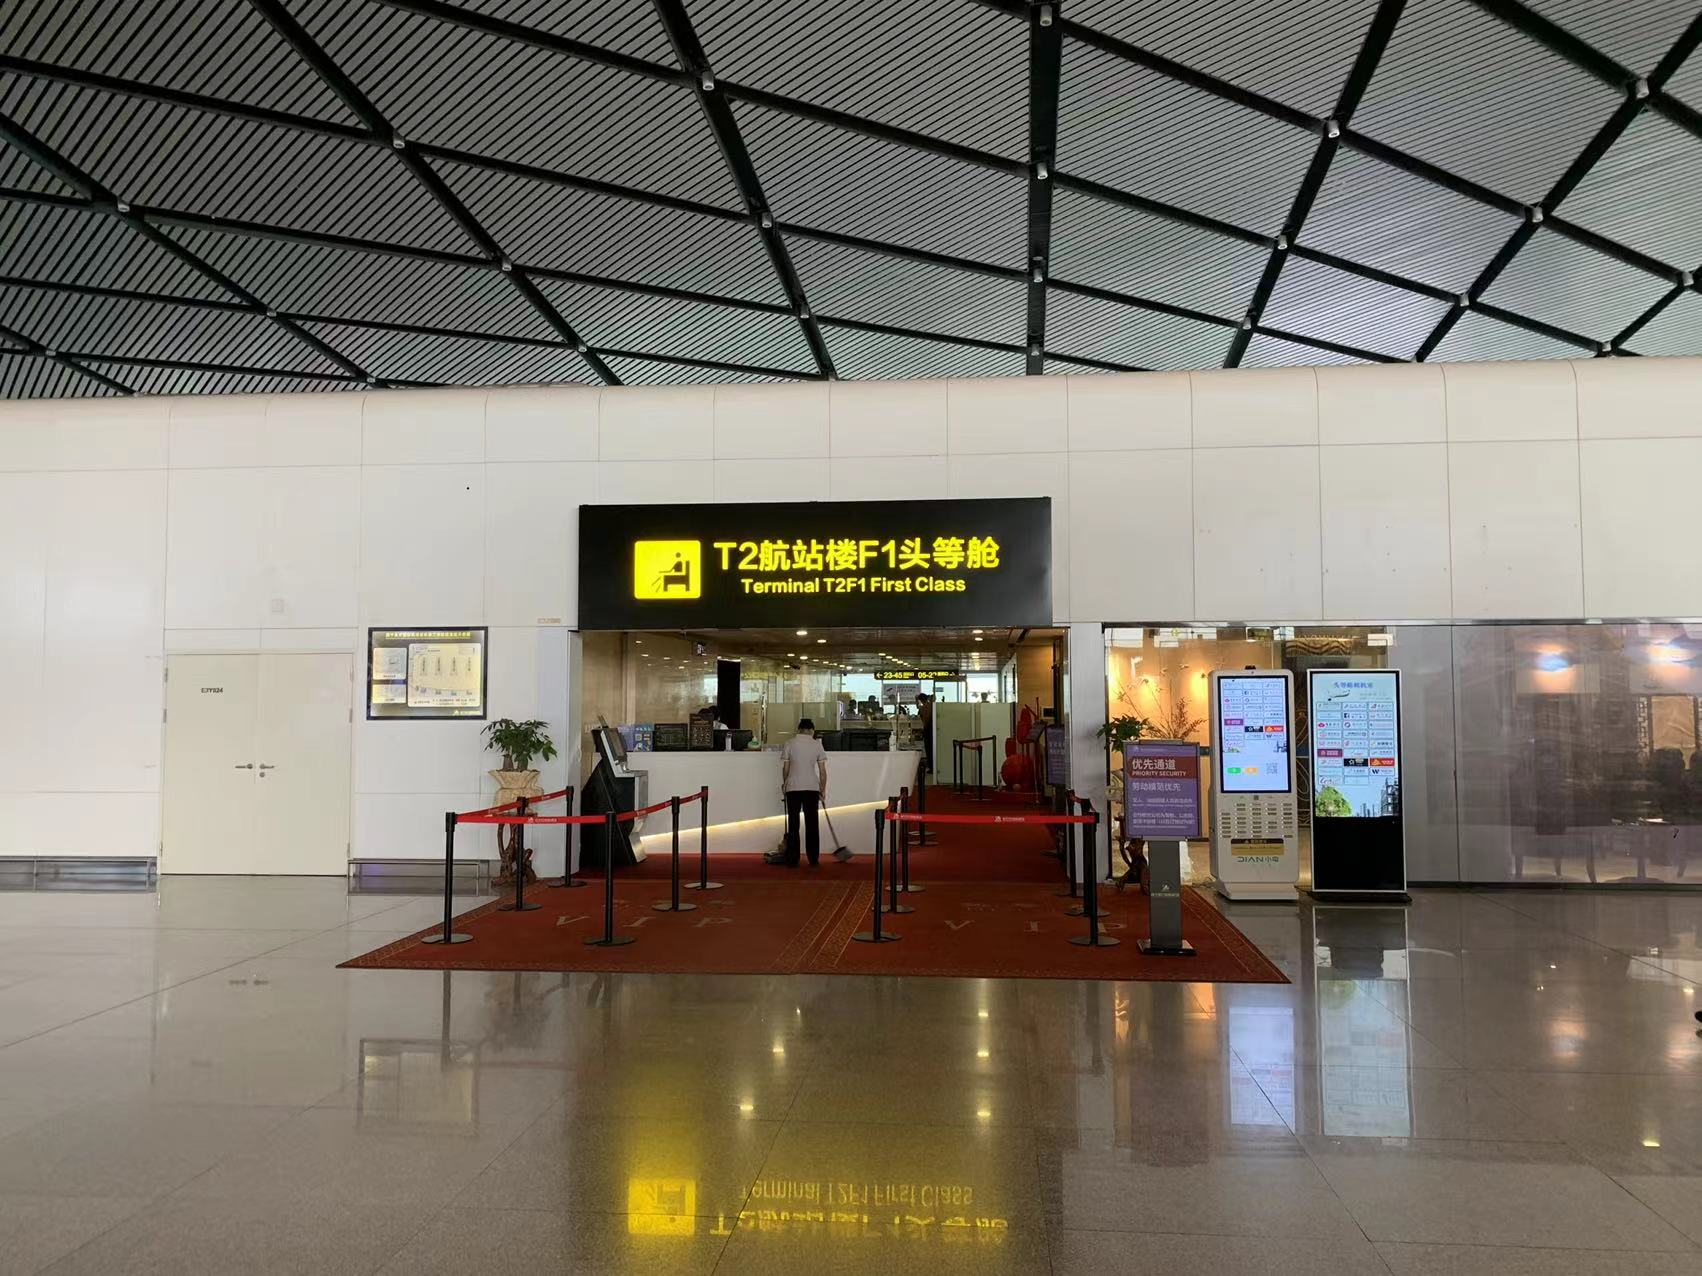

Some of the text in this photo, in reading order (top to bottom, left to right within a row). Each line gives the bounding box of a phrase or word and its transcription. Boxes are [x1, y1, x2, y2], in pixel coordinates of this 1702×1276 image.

[713, 537, 1000, 571] T2航站楼F1头等舱
[741, 575, 966, 594] Terminal T2F1 First Class
[1132, 759, 1176, 770] 优先通道
